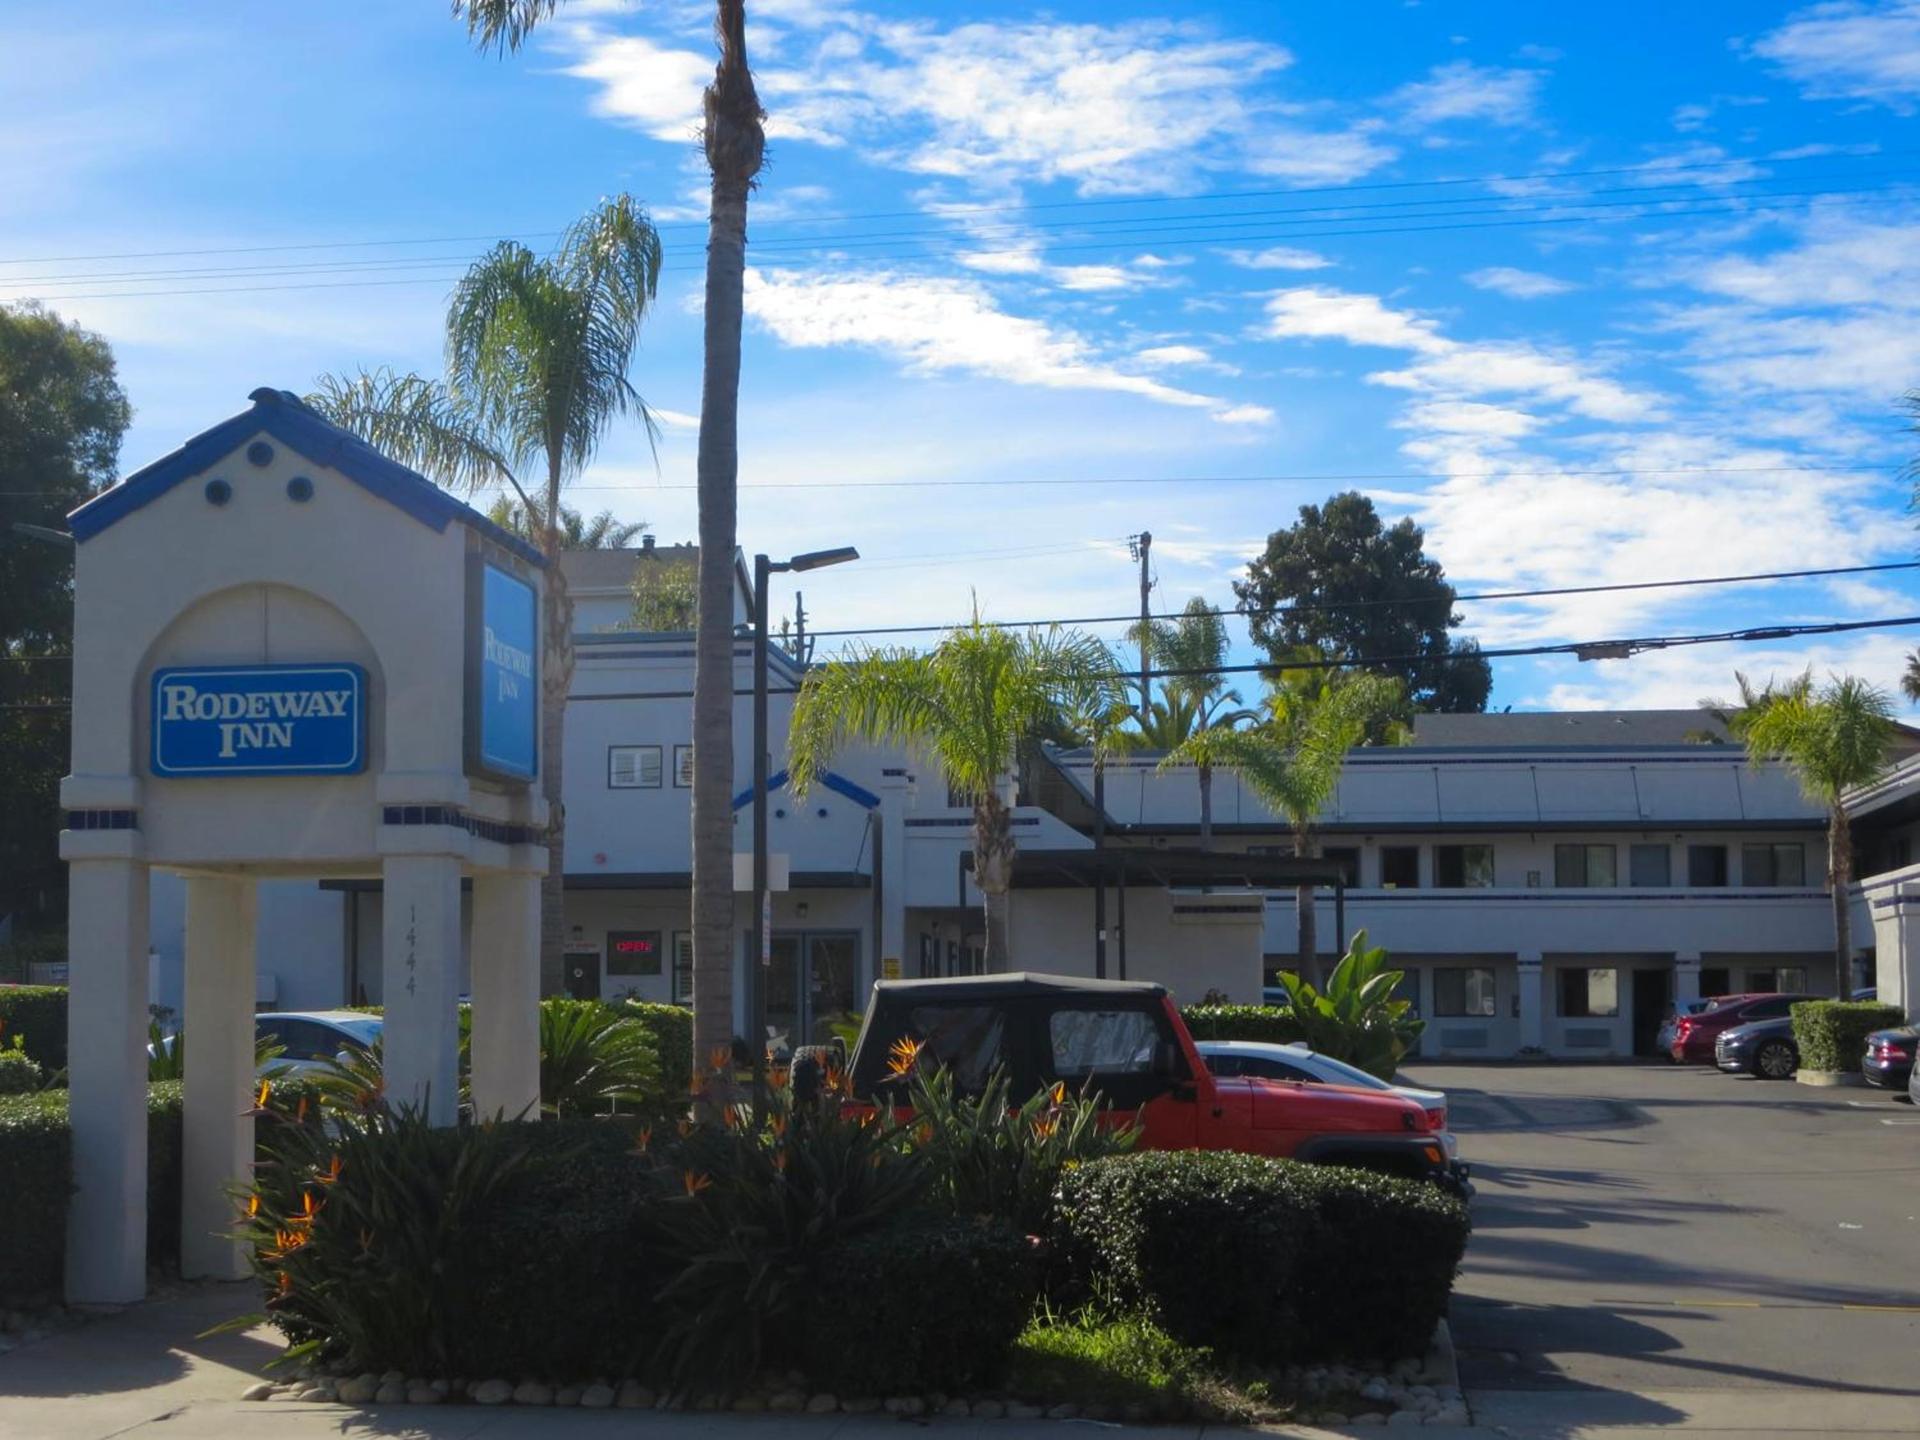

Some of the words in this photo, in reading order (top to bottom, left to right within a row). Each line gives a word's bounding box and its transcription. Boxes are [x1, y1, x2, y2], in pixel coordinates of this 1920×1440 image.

[484, 626, 532, 679] RODEWAY
[163, 685, 351, 721] RODEWAY
[498, 669, 519, 702] INN
[218, 722, 294, 758] INN
[406, 904, 416, 998] 1444
[616, 941, 653, 953] OPEN
